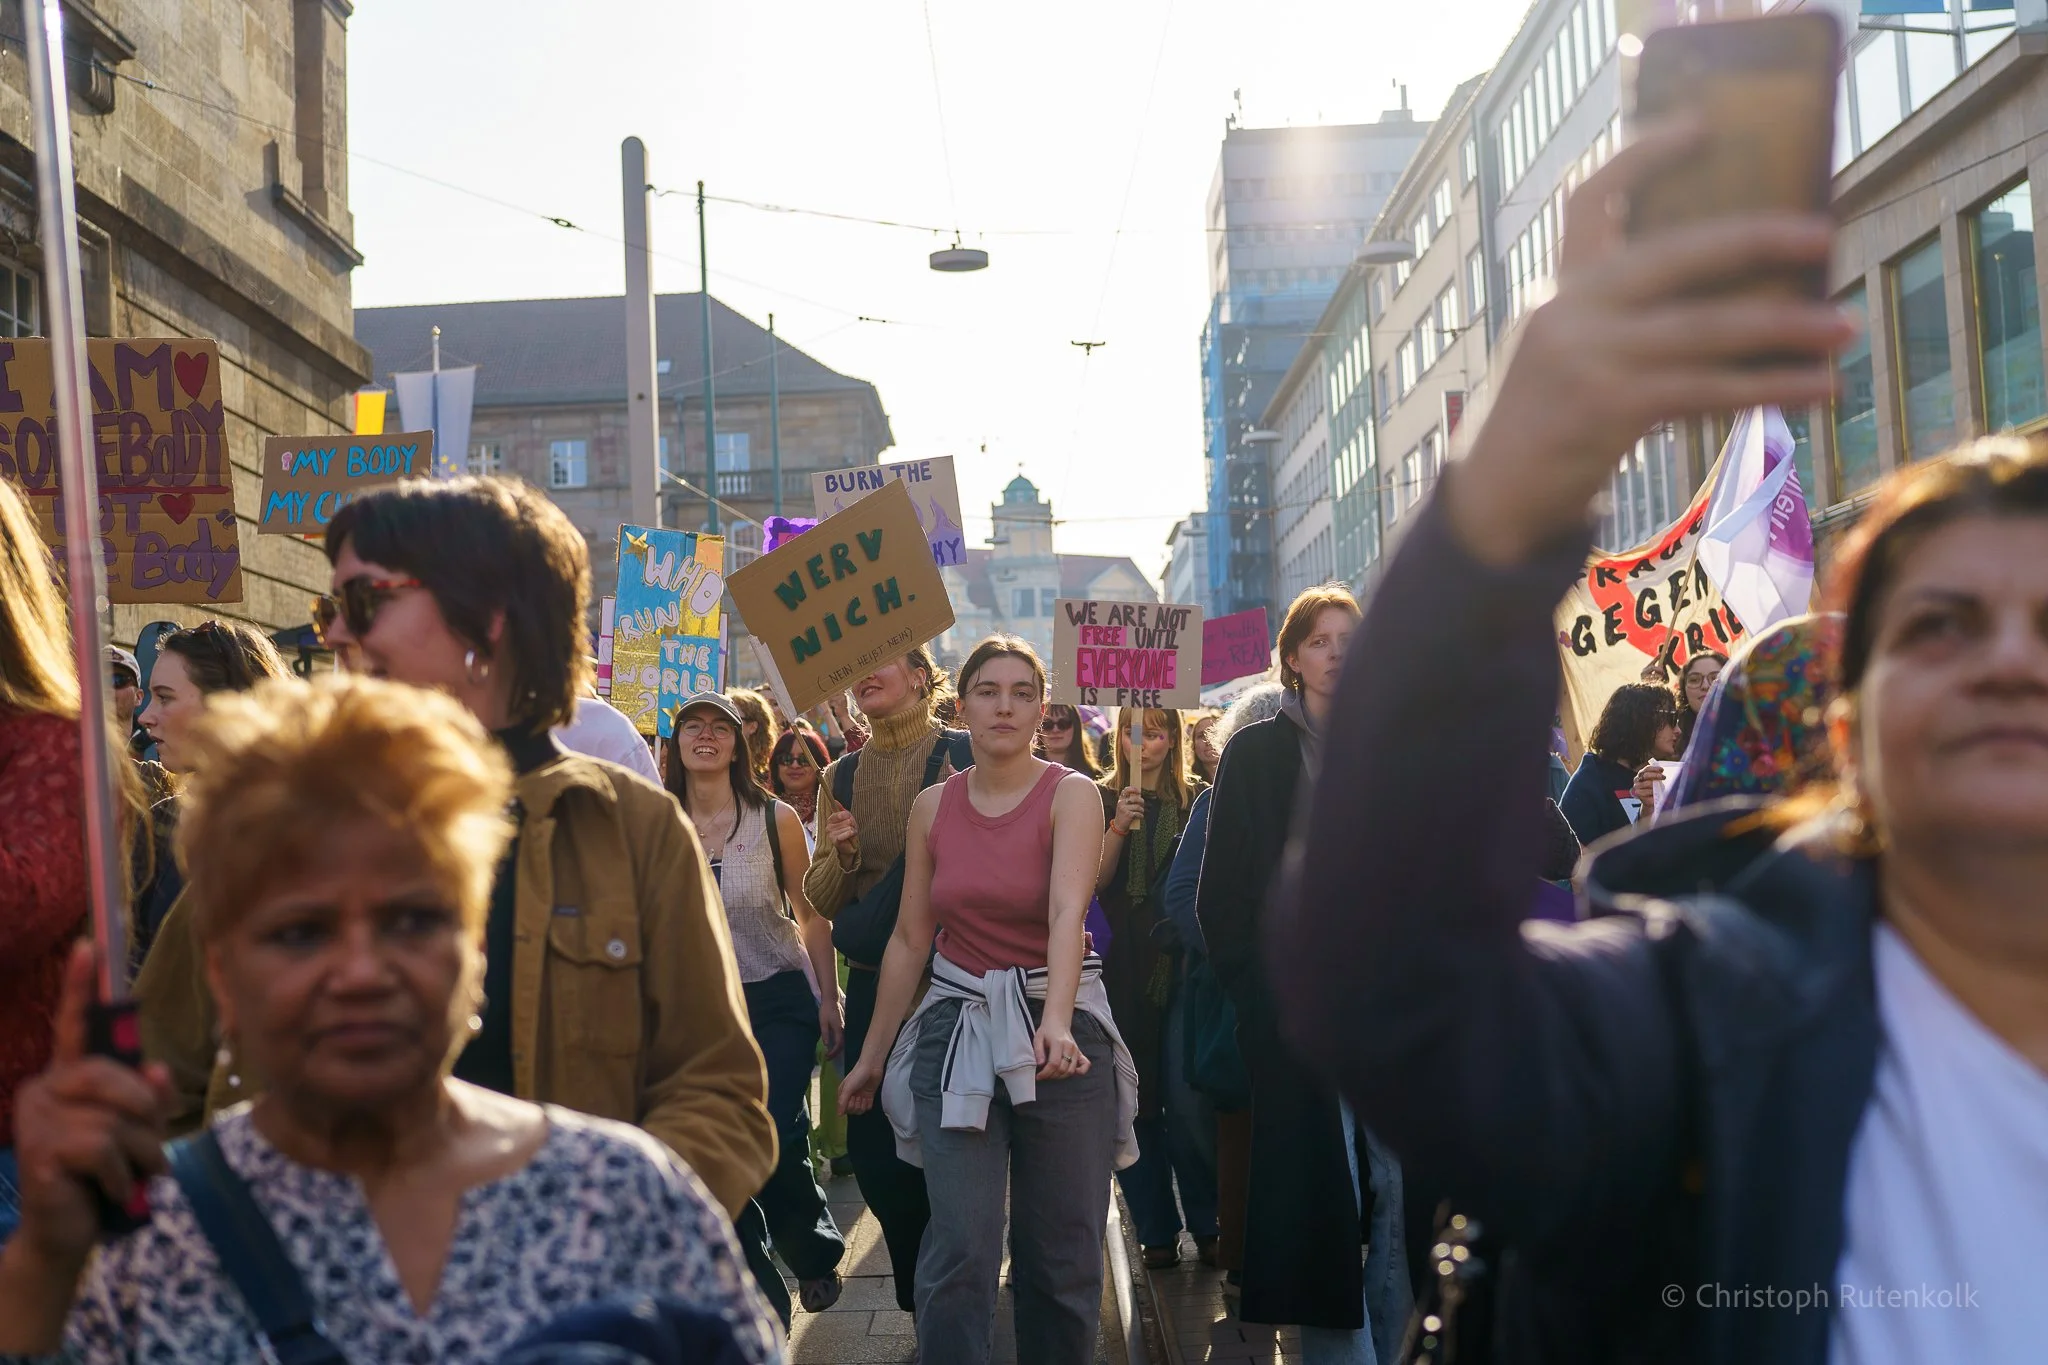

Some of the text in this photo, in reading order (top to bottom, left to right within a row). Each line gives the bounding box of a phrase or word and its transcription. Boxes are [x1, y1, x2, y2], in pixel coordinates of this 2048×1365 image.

[291, 444, 418, 477] MY BODY
[824, 461, 932, 493] BURN THE
[263, 490, 310, 524] MY
[643, 544, 724, 617] WHO
[774, 528, 883, 611] NERV
[619, 601, 680, 642] RUN
[790, 576, 915, 664] NICH.
[1065, 602, 1191, 630] WE ARE NOT
[1082, 625, 1121, 646] FREE
[1135, 627, 1179, 649] UNTIL
[661, 640, 711, 671] THE
[1077, 648, 1177, 689] EVERYONE
[615, 664, 714, 699] WORLD
[1080, 687, 1163, 708] IS FREE
